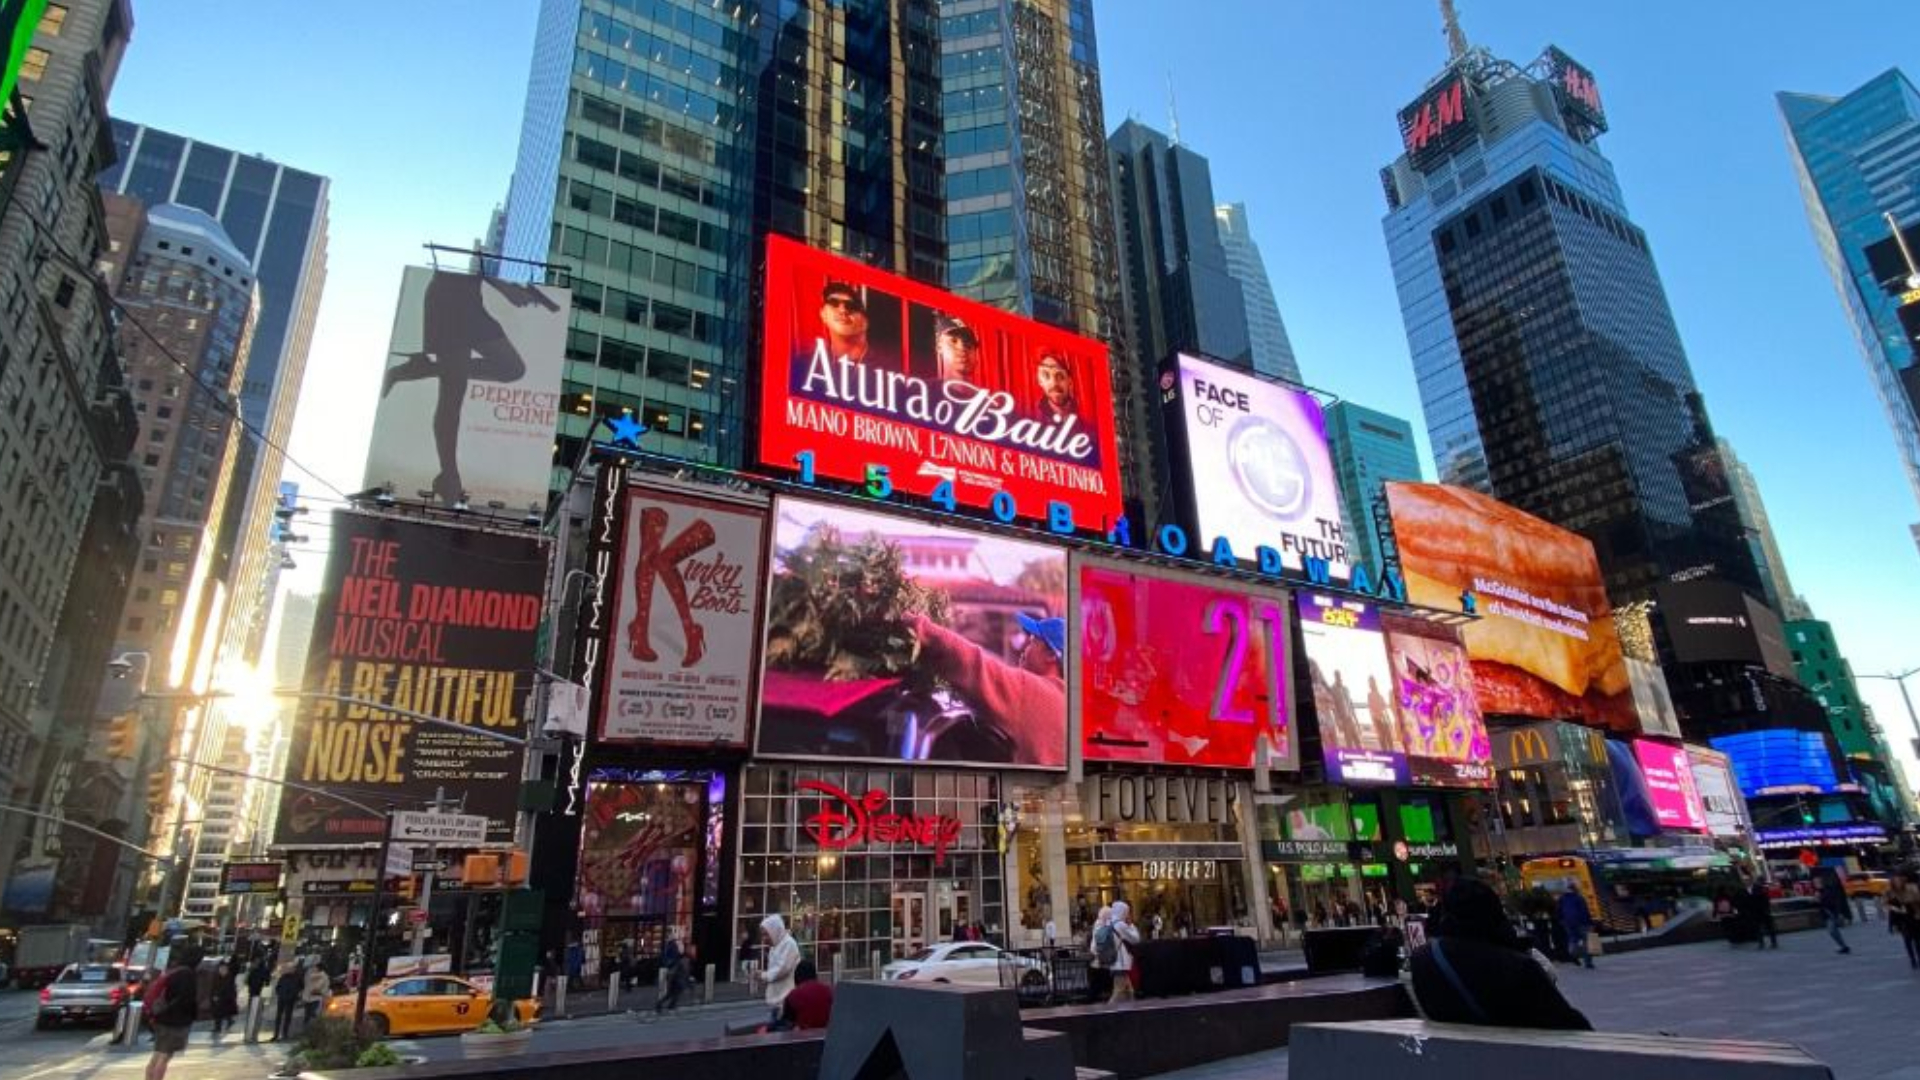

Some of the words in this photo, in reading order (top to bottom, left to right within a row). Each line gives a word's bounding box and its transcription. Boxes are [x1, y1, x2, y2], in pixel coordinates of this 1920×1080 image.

[1408, 80, 1464, 153] H&M
[470, 384, 560, 407] PERFECT
[801, 337, 932, 421] Atura
[1163, 389, 1176, 403] LG
[1193, 378, 1251, 413] FACE
[494, 404, 557, 426] CRIME
[934, 401, 953, 426] o
[943, 379, 1093, 459] Baile
[1196, 404, 1223, 428] OF
[786, 400, 848, 437] MANO
[853, 414, 923, 457] BROWN,
[930, 433, 997, 471] L7NNON
[1001, 450, 1015, 475] &
[793, 450, 1018, 518] 1540
[350, 537, 402, 580] THE
[340, 576, 404, 621] NEIL
[408, 584, 543, 631] DIAMOND
[330, 616, 446, 663] MUSICAL
[314, 660, 342, 719] A
[347, 660, 517, 727] BEAUTIFUL
[303, 720, 412, 784] NOISE
[1100, 775, 1239, 823] FOREVER
[1142, 861, 1199, 880] FOREVER
[1203, 860, 1216, 880] 21
[1295, 842, 1322, 855] POLO
